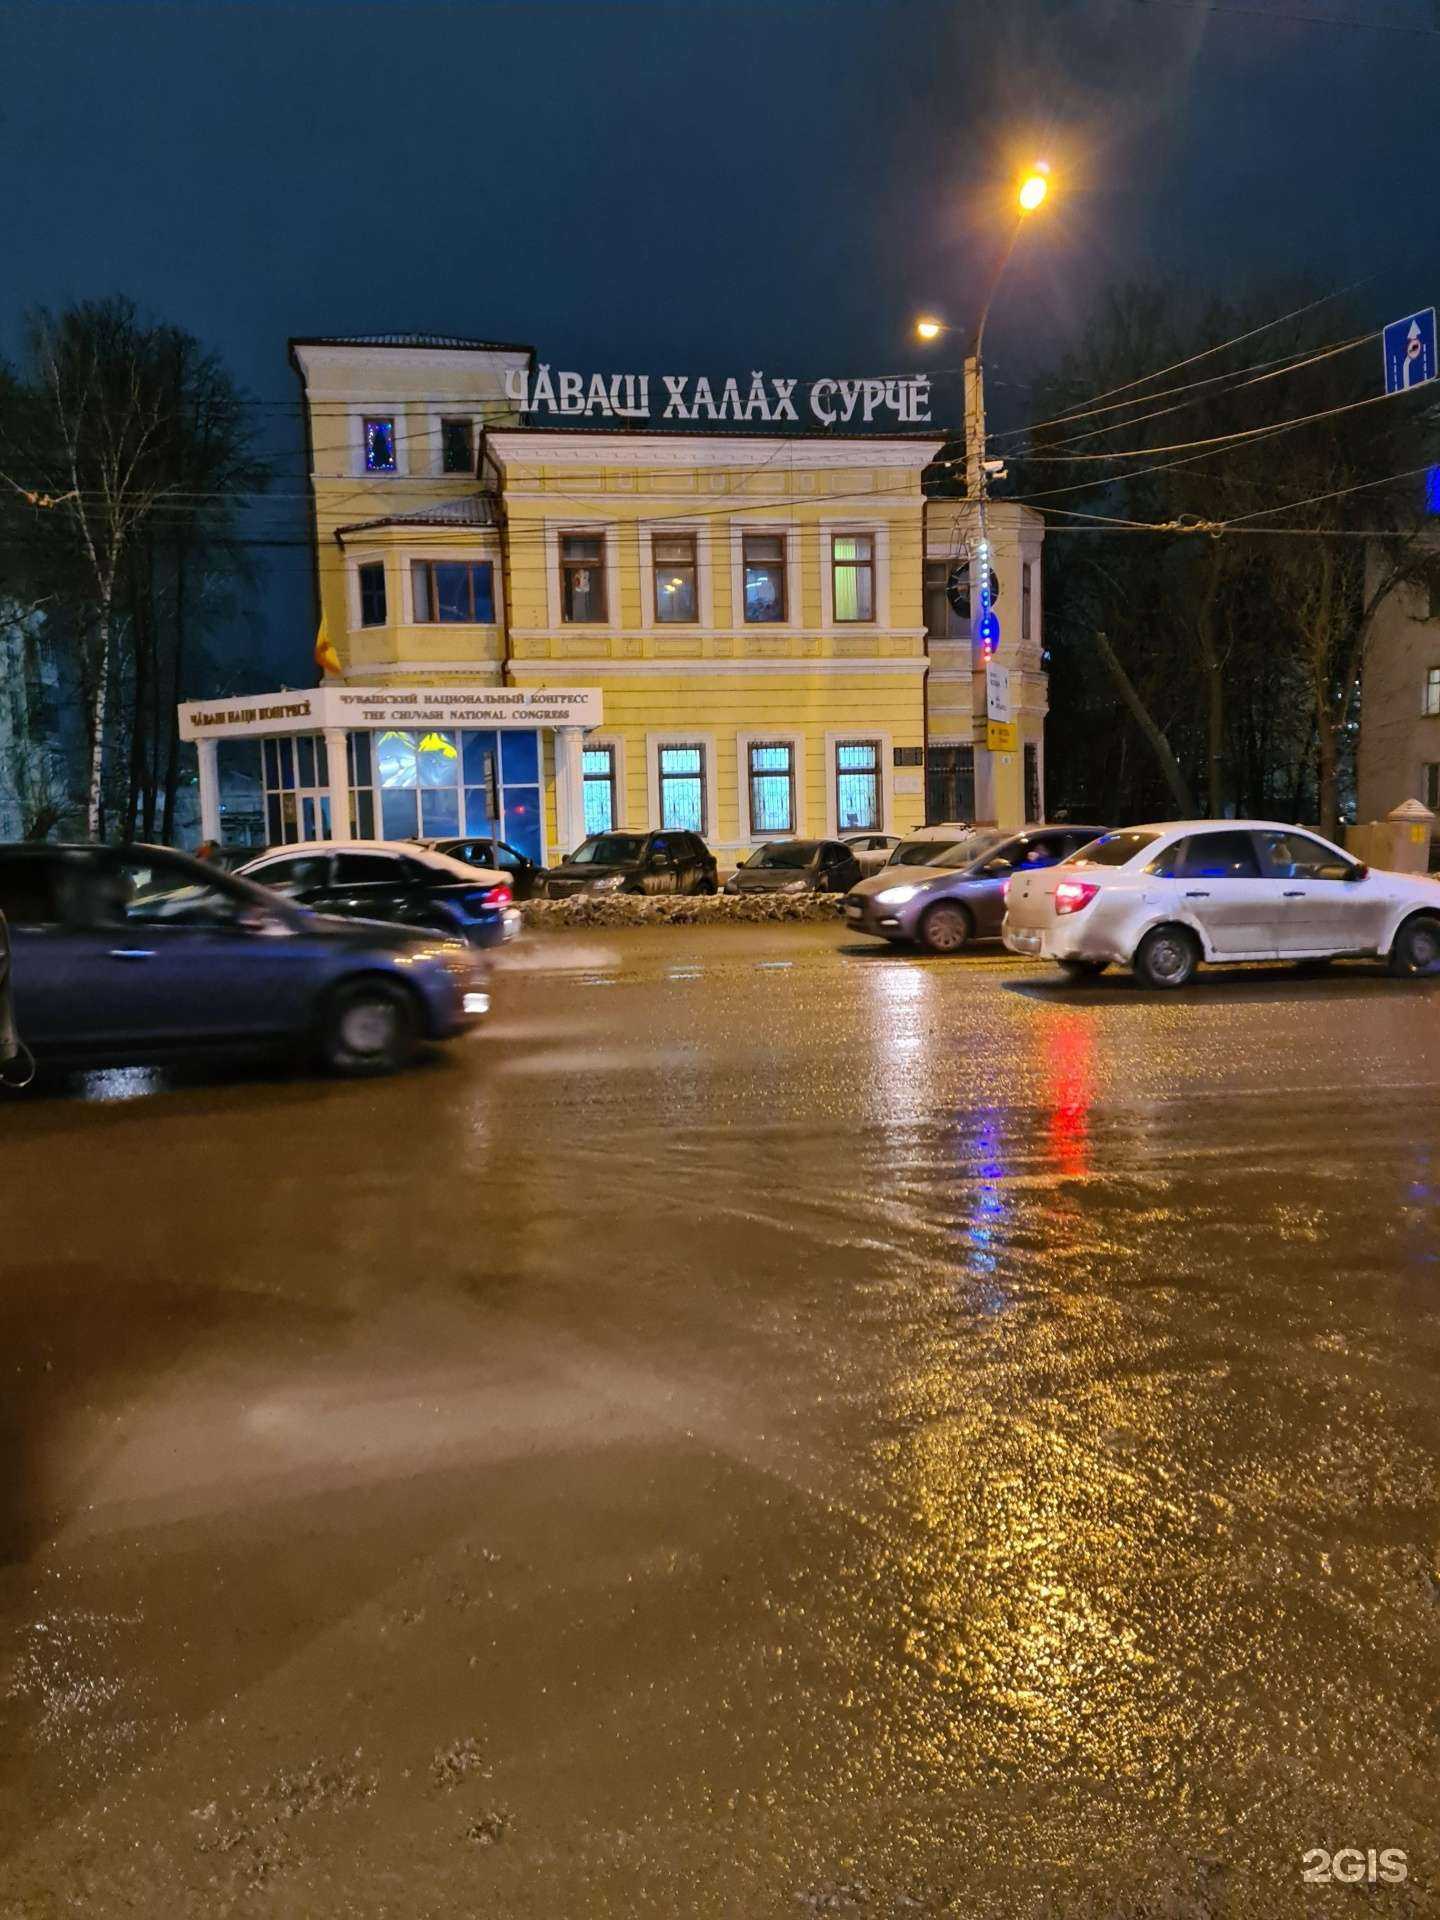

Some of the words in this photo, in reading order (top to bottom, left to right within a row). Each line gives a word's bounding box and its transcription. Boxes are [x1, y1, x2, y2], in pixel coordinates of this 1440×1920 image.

[504, 363, 650, 418] ЧӐВАШ
[662, 371, 799, 420] ХАЛӐХ
[340, 693, 418, 704] ЧУВАШСКИЙ
[424, 693, 524, 706] НАЦИОНАЛЬНЫЙ
[531, 694, 588, 704] КОНГРЕСС
[362, 710, 385, 720] THE
[391, 710, 443, 720] CHUVASH
[450, 710, 506, 720] NATIONAL
[512, 710, 569, 720] CONGRESS
